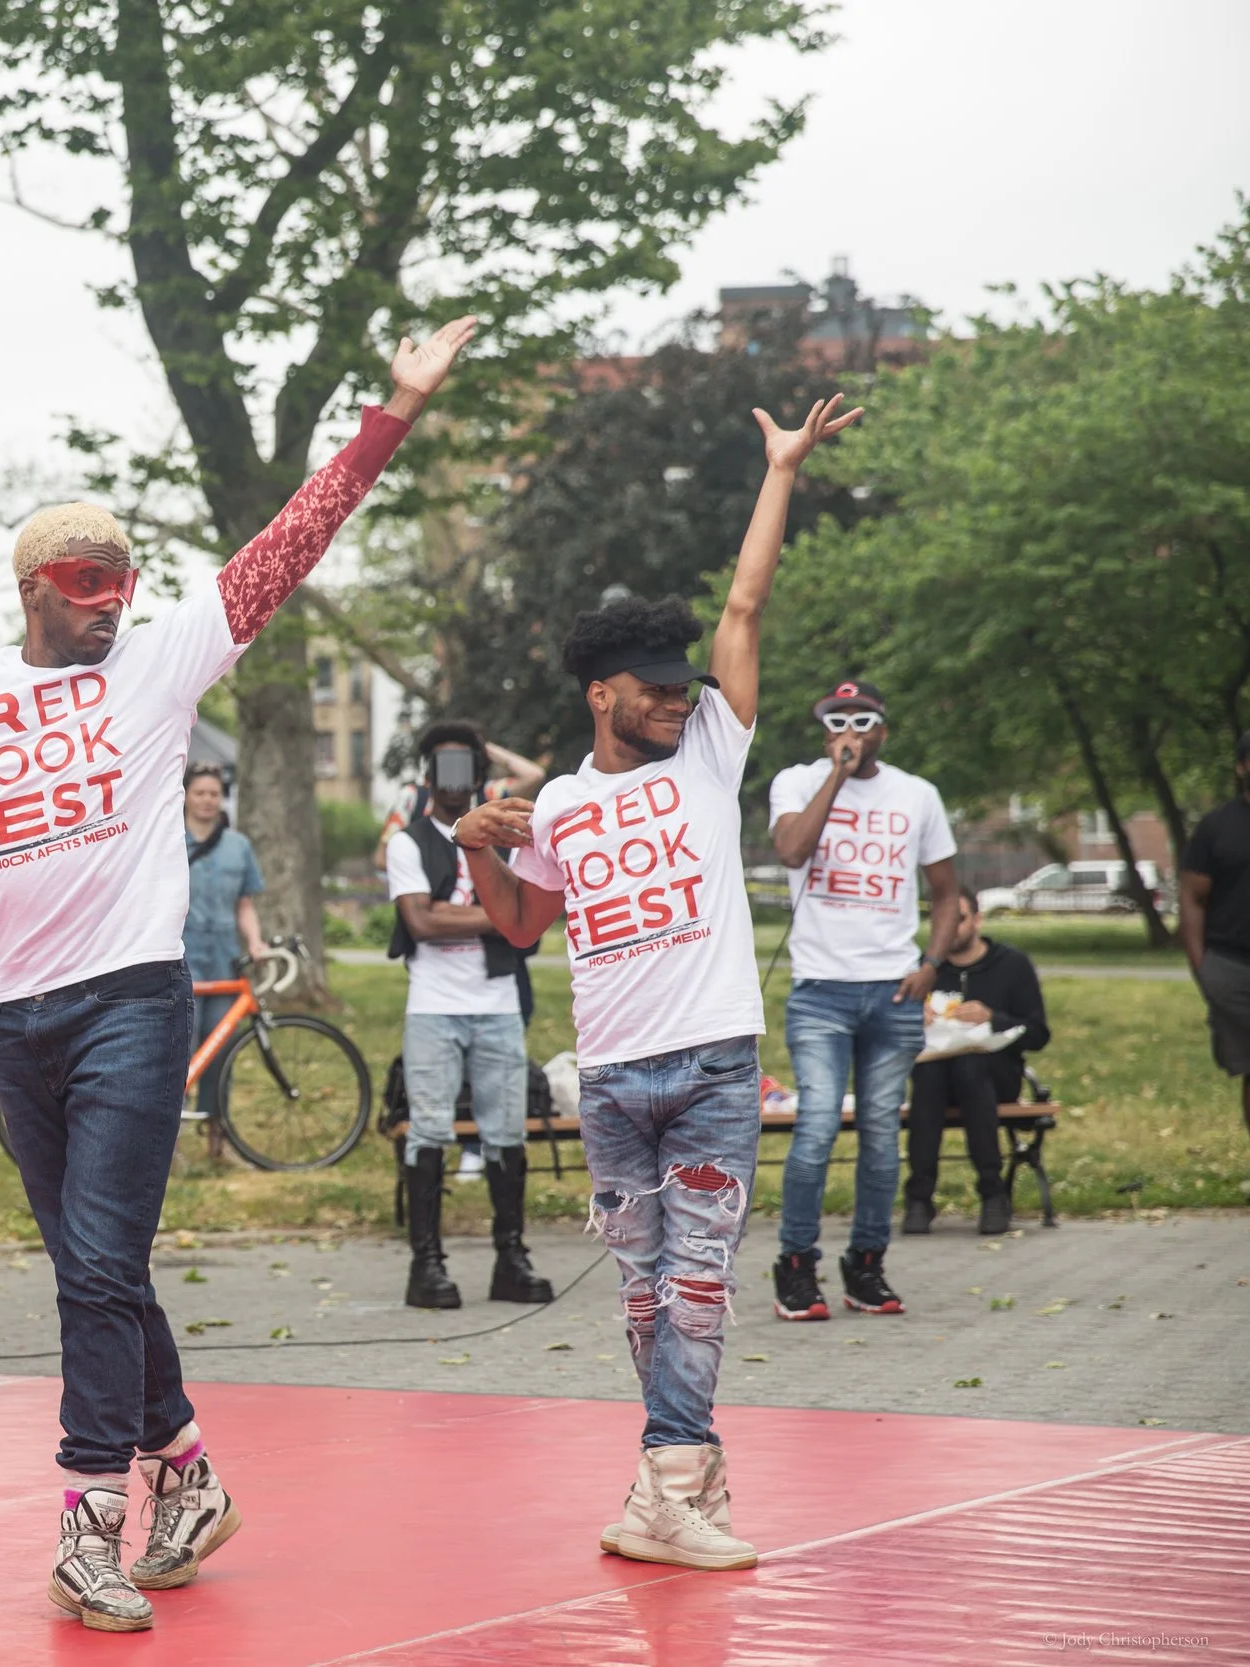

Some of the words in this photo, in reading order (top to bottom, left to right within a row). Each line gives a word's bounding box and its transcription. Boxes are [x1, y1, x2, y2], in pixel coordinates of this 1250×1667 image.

[550, 776, 680, 852] RED
[827, 807, 909, 835] RED
[37, 838, 81, 860] ARTS
[83, 822, 129, 845] MEDIA
[808, 866, 905, 901] FEST
[567, 874, 703, 952] FEST
[589, 948, 630, 968] HOOK
[628, 938, 670, 959] ARTS
[672, 926, 711, 946] MEDIA
